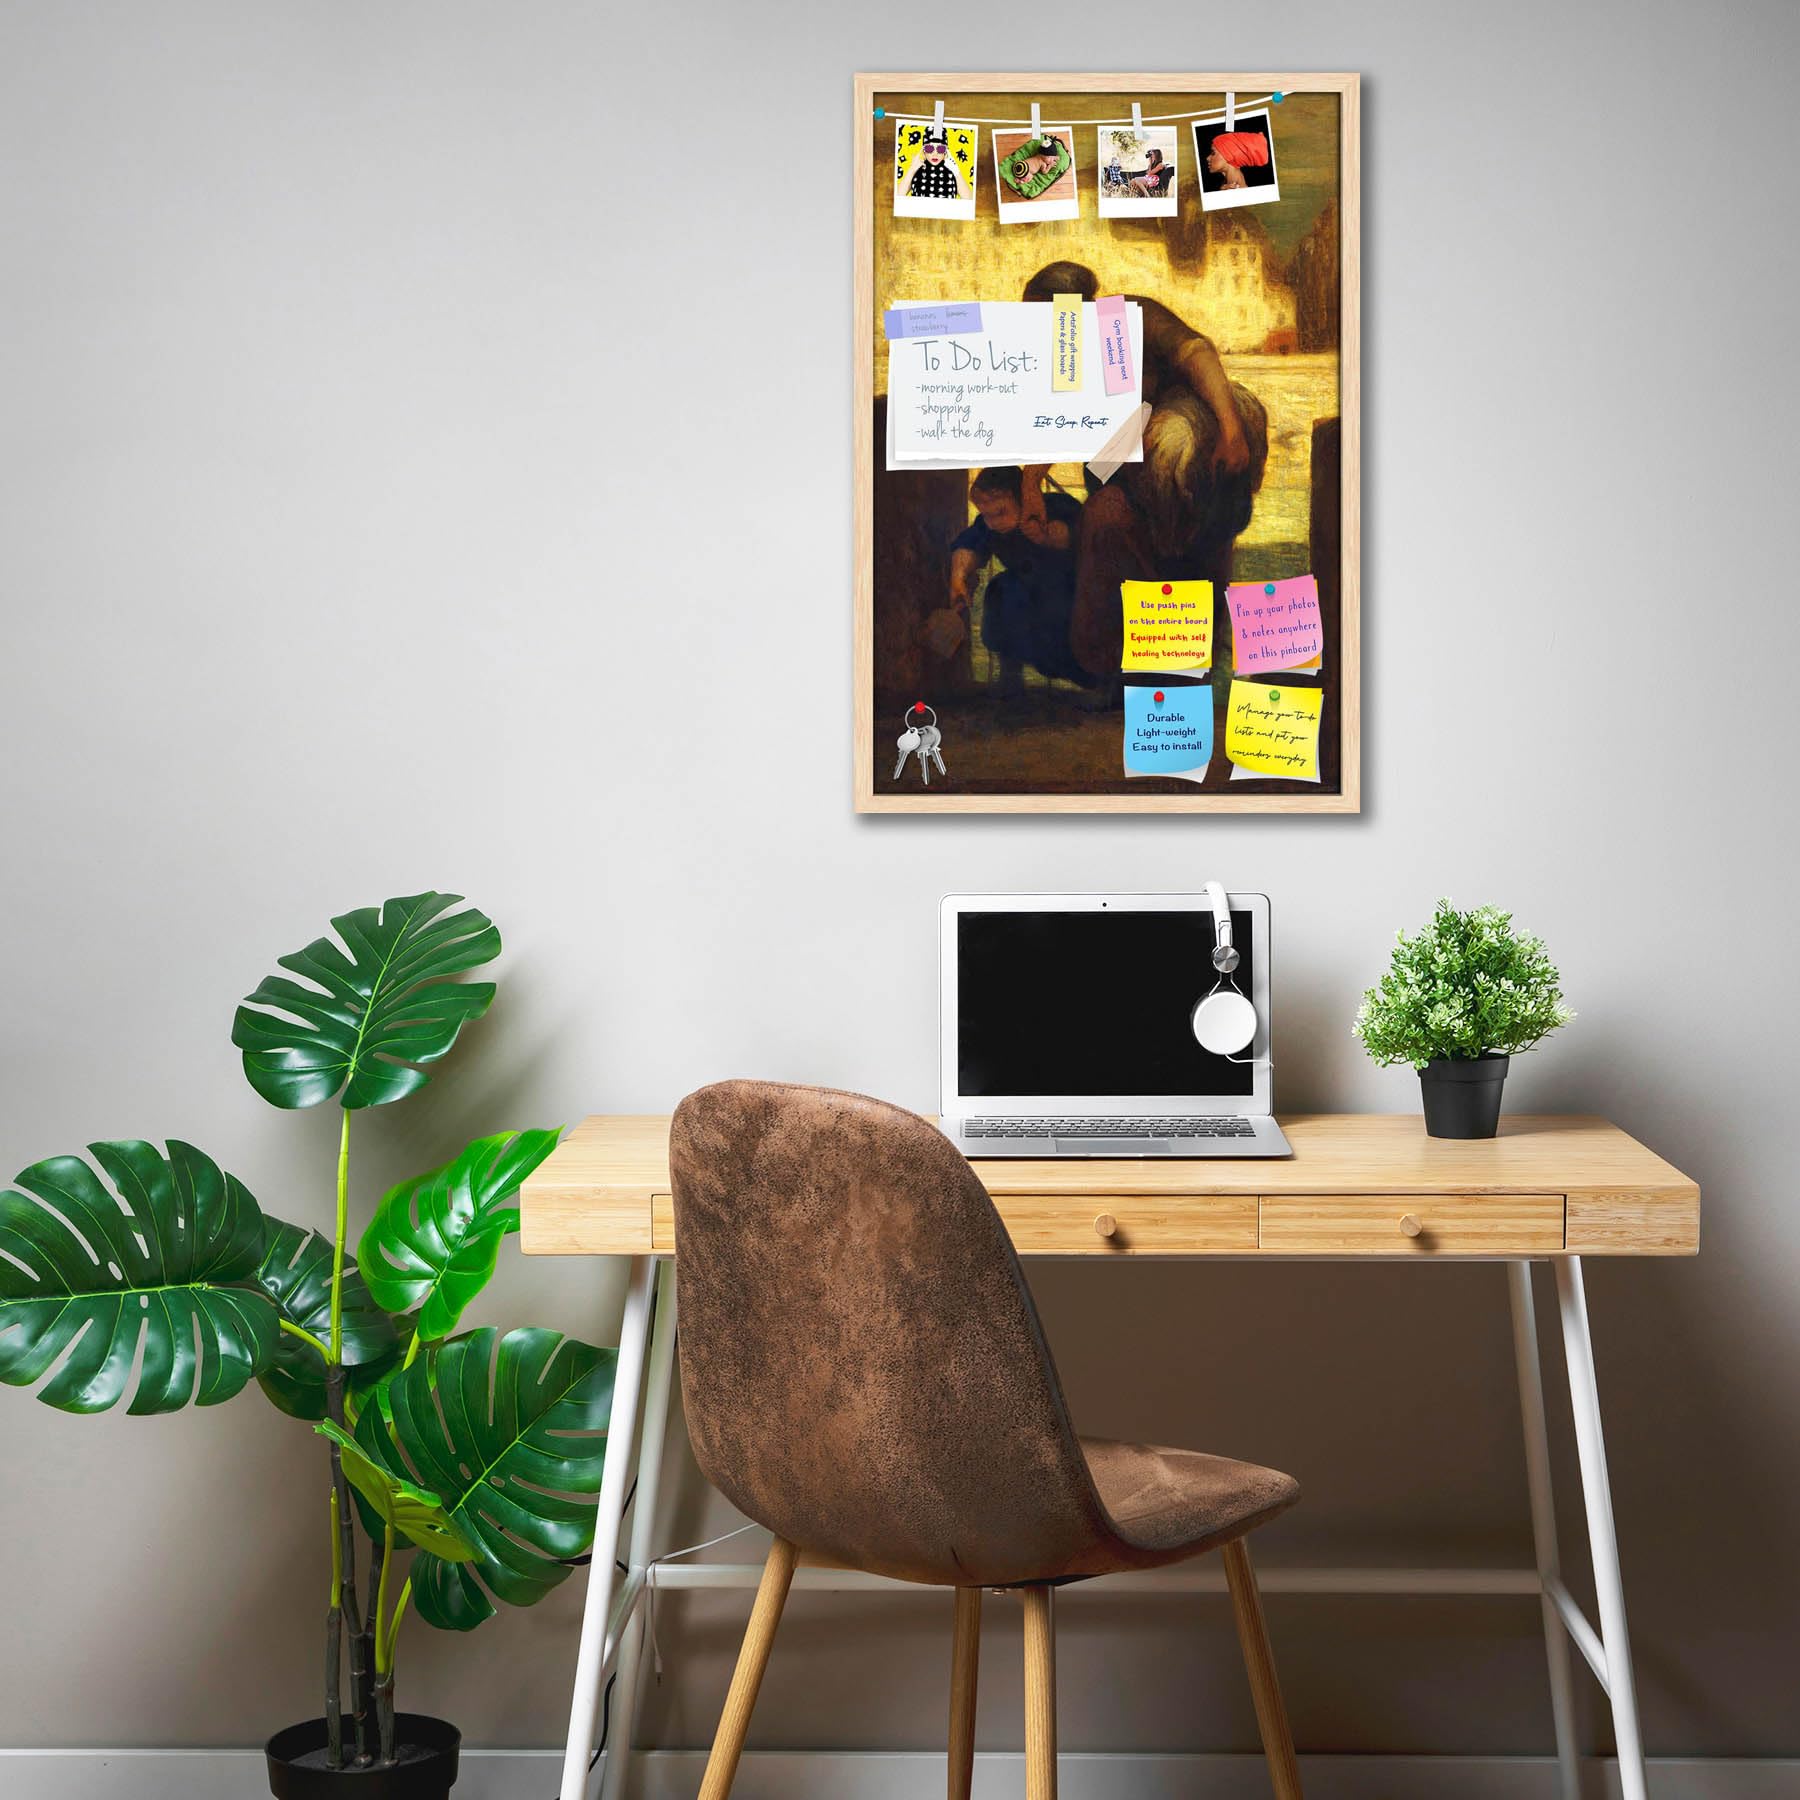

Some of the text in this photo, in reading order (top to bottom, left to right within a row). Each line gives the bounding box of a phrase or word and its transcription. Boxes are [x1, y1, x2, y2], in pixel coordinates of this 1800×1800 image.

[1059, 311, 1067, 331] Papers
[1059, 339, 1067, 354] glass
[1068, 342, 1078, 354] gift
[1106, 336, 1117, 366] weekend
[1113, 319, 1129, 381] Gym booking next
[912, 340, 1038, 373] To Do List:
[1059, 354, 1067, 375] boards
[1068, 354, 1076, 382] wrapping
[967, 375, 1020, 394] work-out
[950, 419, 972, 438] the
[974, 420, 994, 447] dog
[1141, 600, 1196, 611] Use push pins
[1236, 596, 1317, 618] Pin up your photos
[1141, 617, 1155, 626] the
[1158, 617, 1182, 625] entire
[1184, 616, 1208, 625] board
[1241, 619, 1317, 639] & notes anywhere
[1130, 632, 1206, 644] Equipped with self
[1132, 649, 1206, 659] healing technology
[1261, 645, 1277, 658] this
[1280, 639, 1317, 659] pinboard
[1147, 713, 1185, 722] Durable
[1236, 702, 1274, 720] Manage
[1137, 727, 1197, 739] Light-weight
[1256, 729, 1274, 739] and
[1274, 730, 1293, 742] put
[1132, 742, 1158, 753] Easy
[1172, 741, 1202, 750] install
[1274, 753, 1307, 767] everyday
